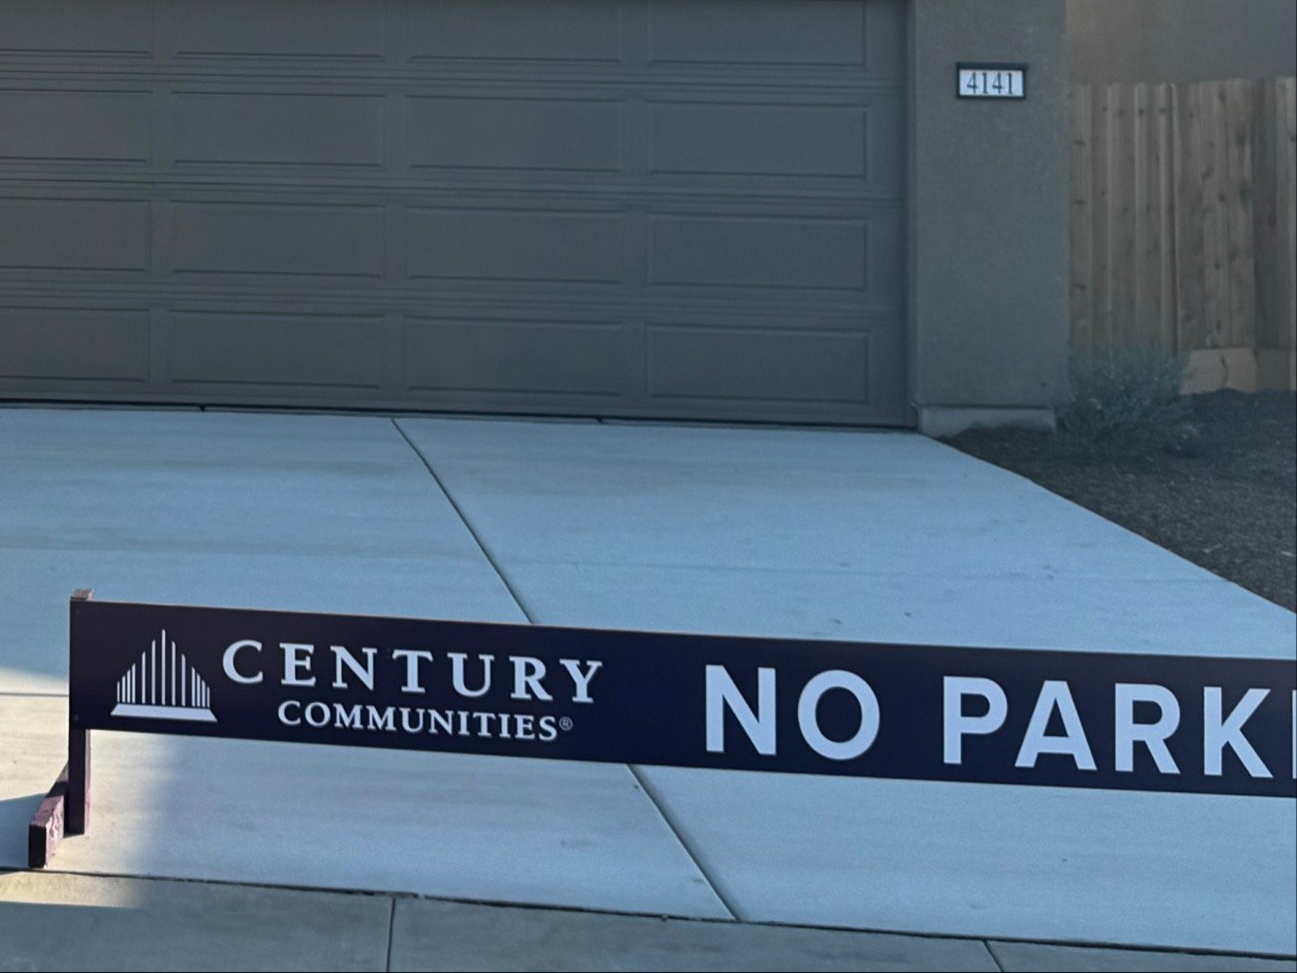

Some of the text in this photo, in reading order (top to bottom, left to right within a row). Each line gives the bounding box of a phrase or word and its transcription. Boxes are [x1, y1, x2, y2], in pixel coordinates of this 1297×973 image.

[966, 72, 1014, 94] 4141
[222, 639, 603, 704] CENTURY
[705, 664, 1296, 780] NO PARK
